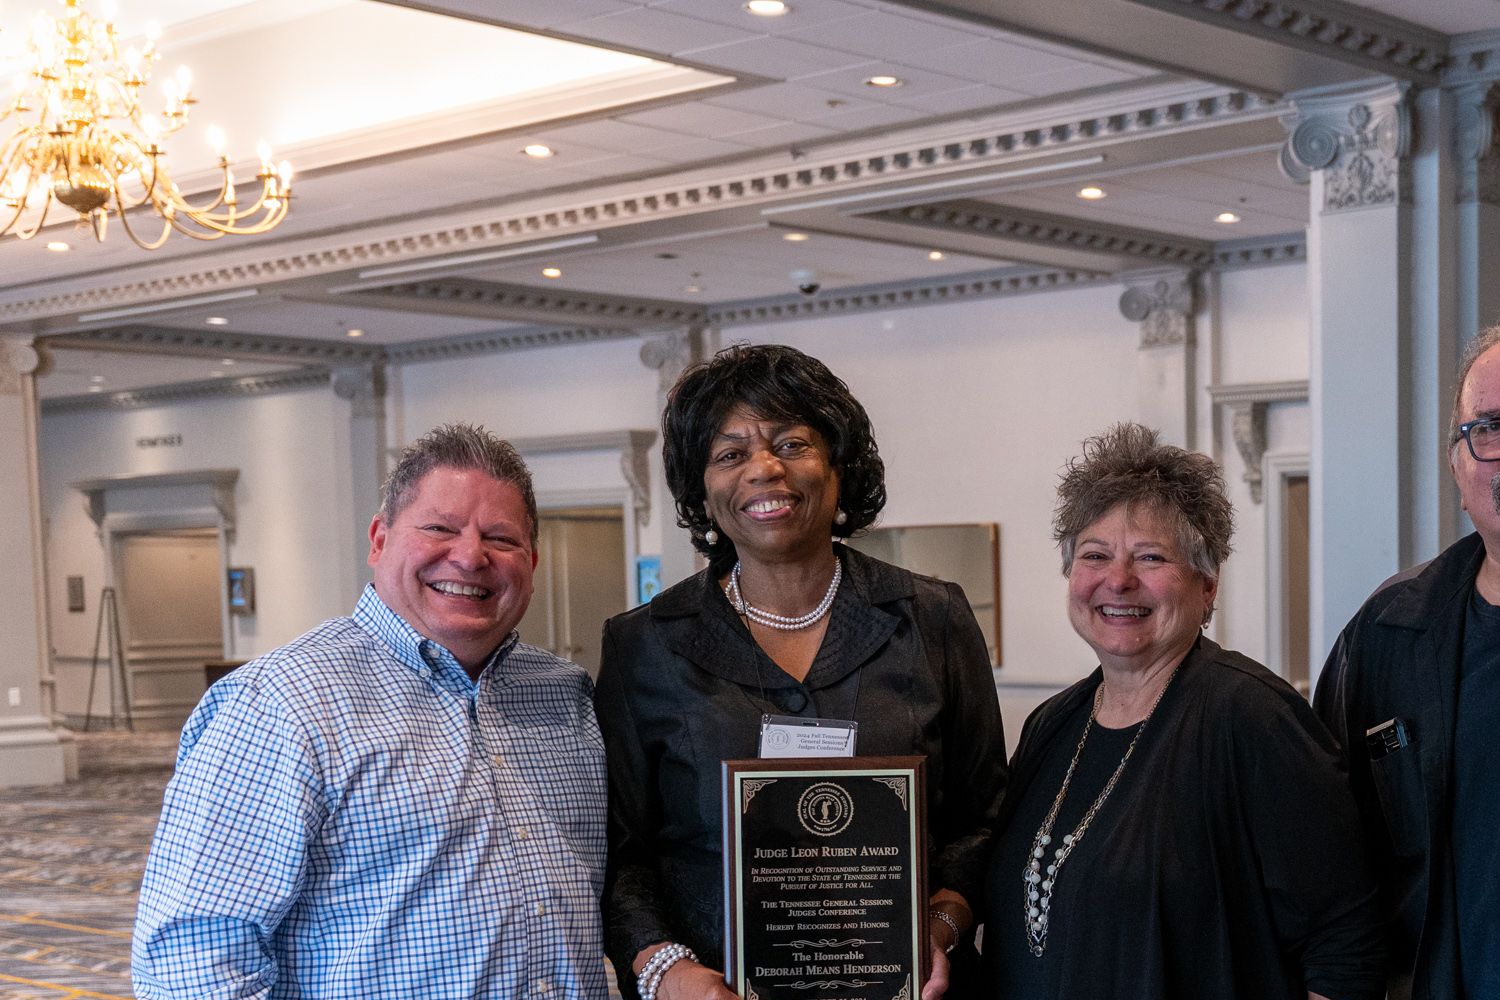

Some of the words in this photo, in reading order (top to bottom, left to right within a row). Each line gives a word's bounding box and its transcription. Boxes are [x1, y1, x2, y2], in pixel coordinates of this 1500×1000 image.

[754, 848, 788, 858] JUDGE
[791, 847, 818, 858] LEON
[822, 847, 856, 857] RUBEN
[860, 846, 898, 856] AWARD
[779, 900, 820, 908] TENNESSEE
[818, 908, 866, 916] CONFERENCE
[792, 953, 811, 961] The
[814, 951, 864, 960] Honorable
[755, 967, 802, 976] DEBORAH
[806, 965, 840, 975] MEANS
[843, 964, 901, 974] HENDERSON
